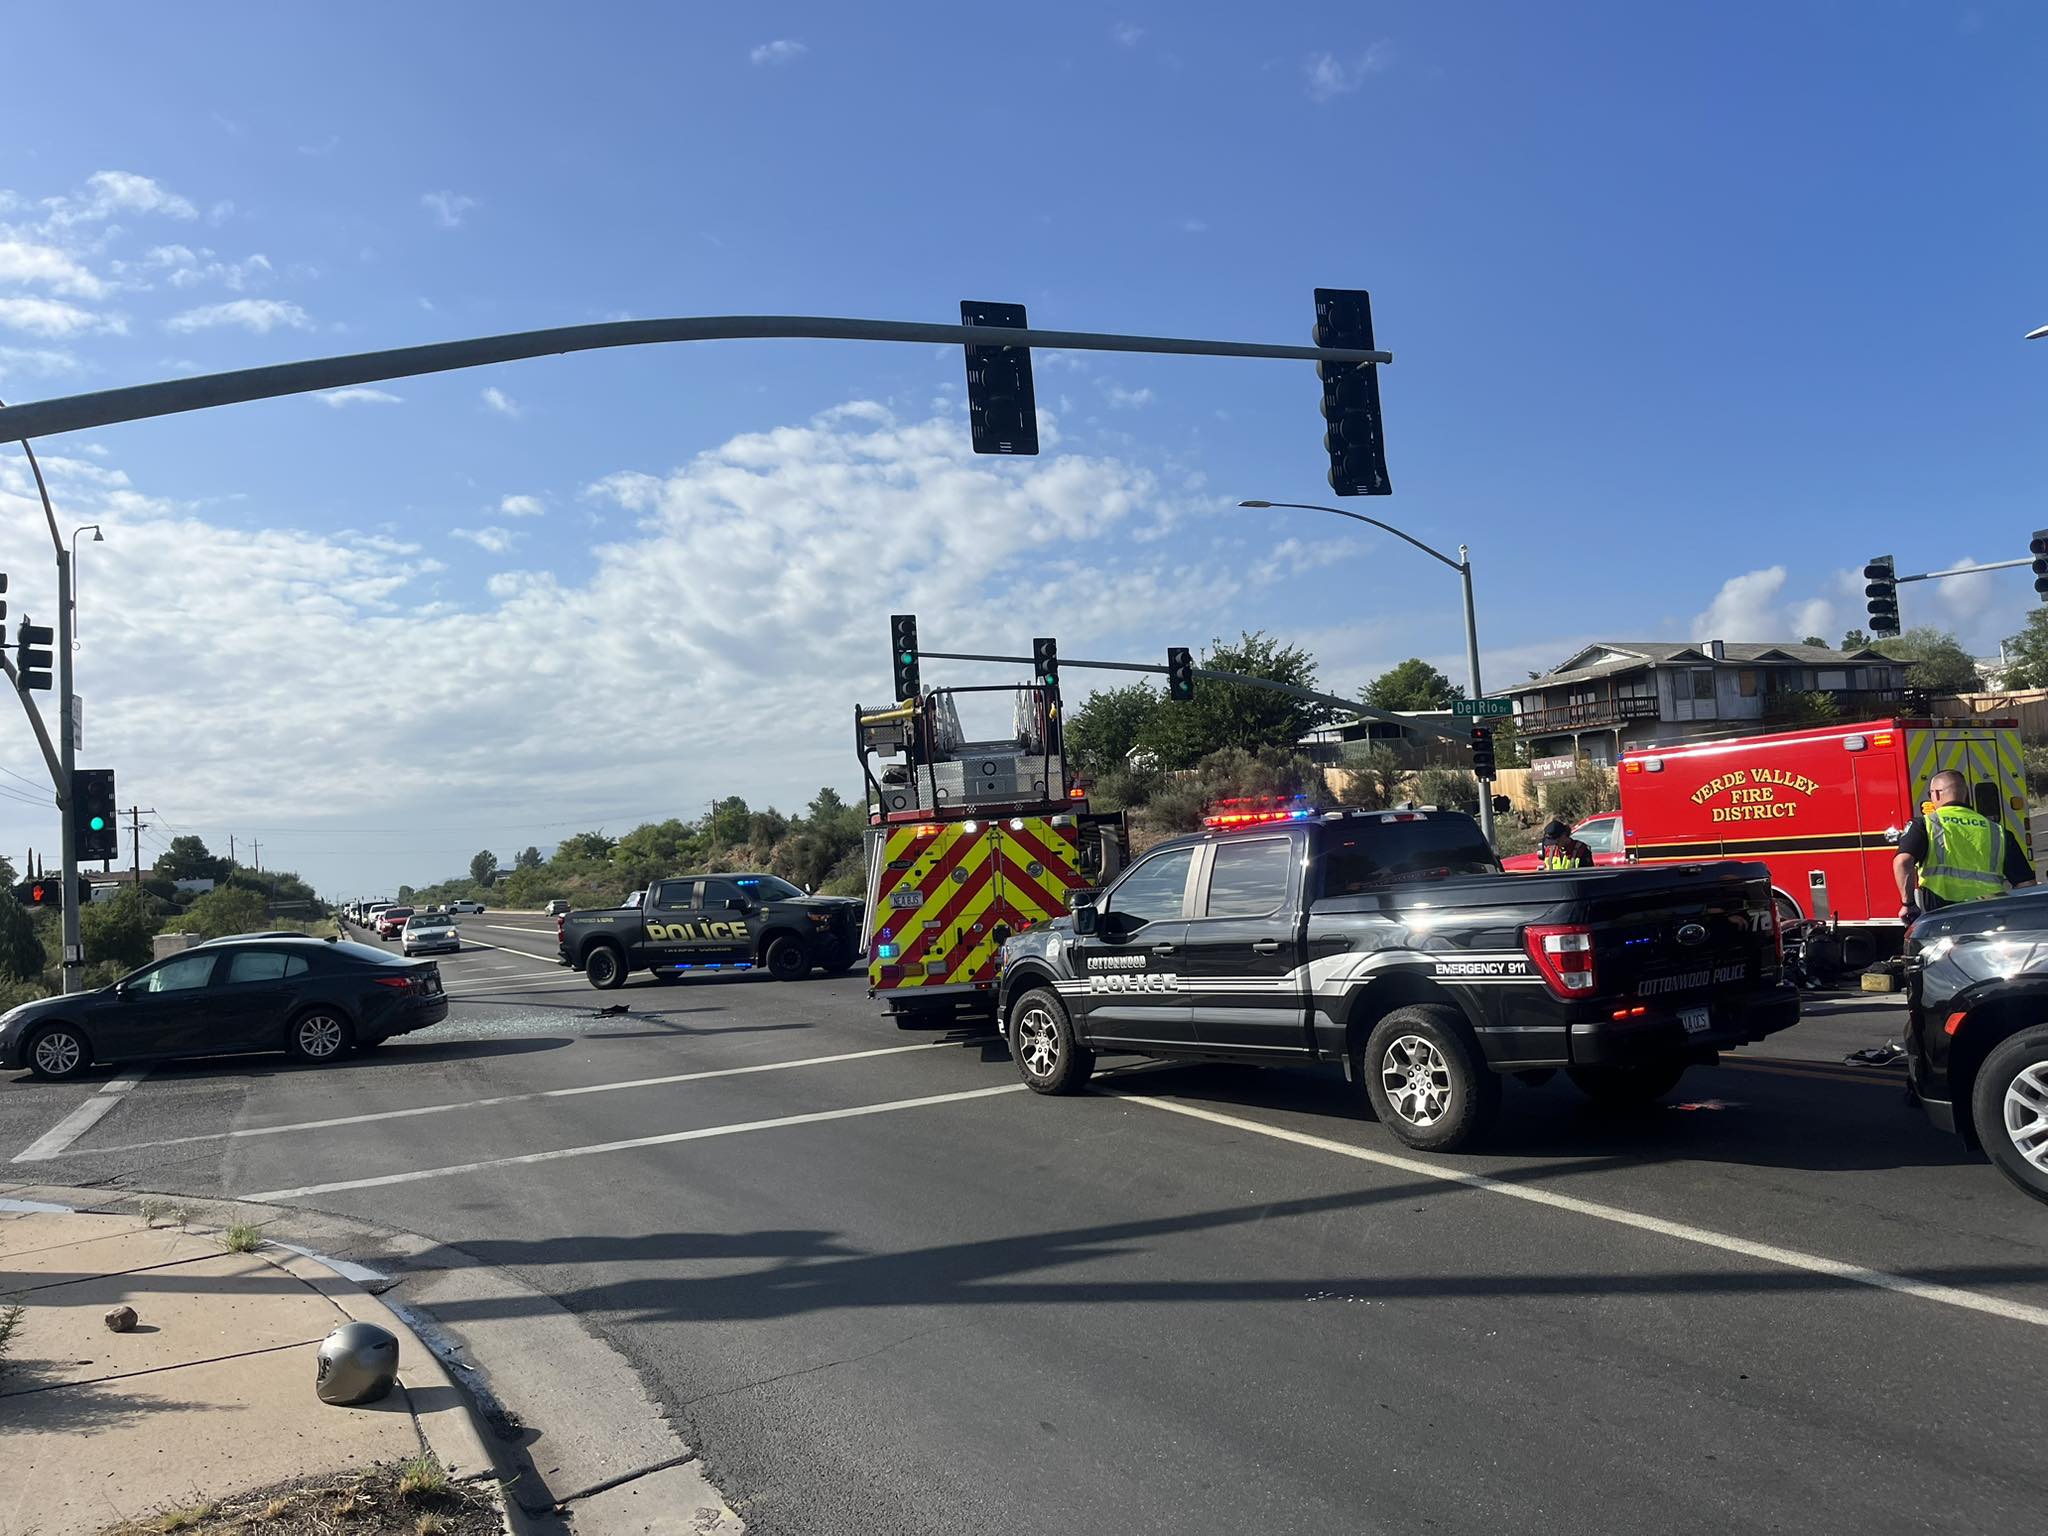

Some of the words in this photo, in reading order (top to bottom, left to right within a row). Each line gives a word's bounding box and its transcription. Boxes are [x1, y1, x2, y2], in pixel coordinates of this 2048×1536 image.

[1457, 700, 1476, 714] Del
[1480, 700, 1498, 713] Rio
[1533, 761, 1551, 771] Verde
[1552, 759, 1573, 770] Village
[1690, 770, 1746, 805] VERDE
[1750, 768, 1820, 797] VALLEY
[1731, 787, 1774, 804] FIRE
[1712, 801, 1797, 822] DISTRICT
[1942, 816, 1988, 828] POLICE
[646, 921, 750, 942] POLICE
[1087, 955, 1147, 970] COTTONWOOD
[1435, 963, 1505, 975] EMERGENCY
[1508, 962, 1527, 974] 911
[1088, 973, 1180, 995] POLICE
[1637, 970, 1710, 997] COTTONWOOD
[1713, 964, 1746, 985] POLICE
